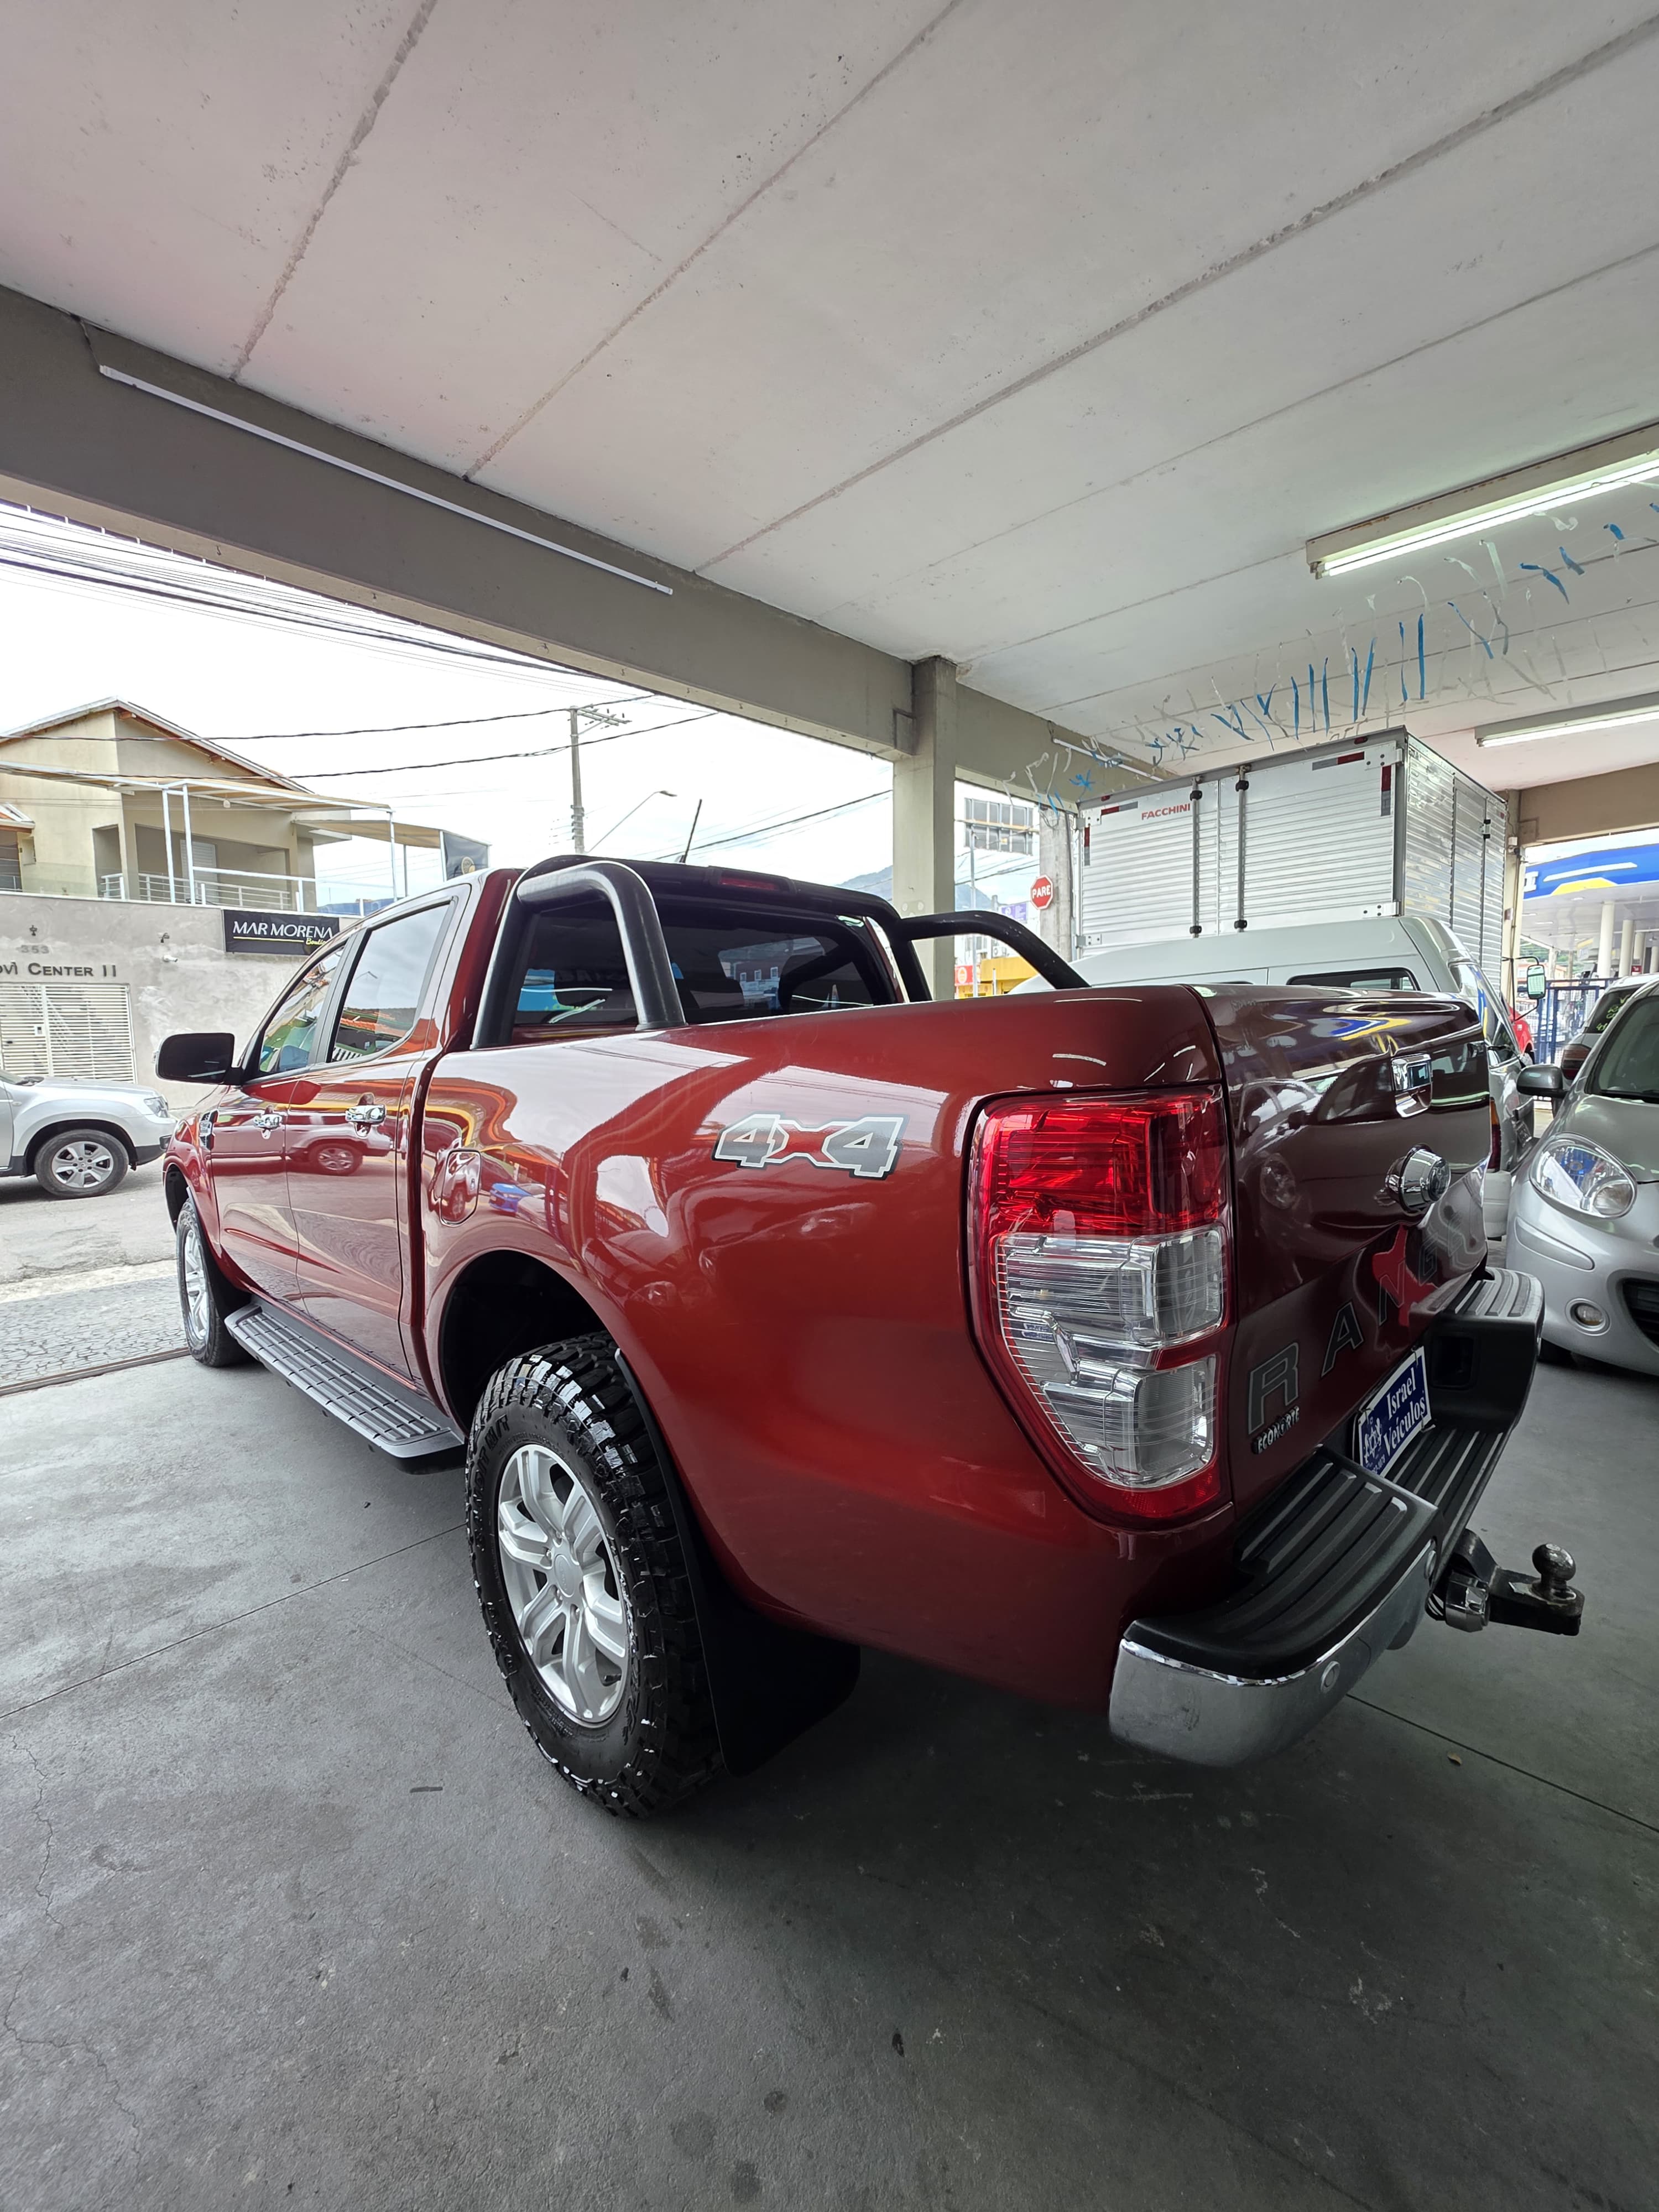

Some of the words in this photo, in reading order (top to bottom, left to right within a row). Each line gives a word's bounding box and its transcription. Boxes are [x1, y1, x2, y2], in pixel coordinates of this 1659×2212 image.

[1141, 804, 1191, 820] FACCHINI
[1032, 885, 1051, 899] PARE
[233, 921, 268, 935] MAR
[270, 923, 332, 938] MORENA
[20, 945, 49, 954] 353
[1386, 1366, 1416, 1421] Israel
[1384, 1396, 1426, 1457] Veículos
